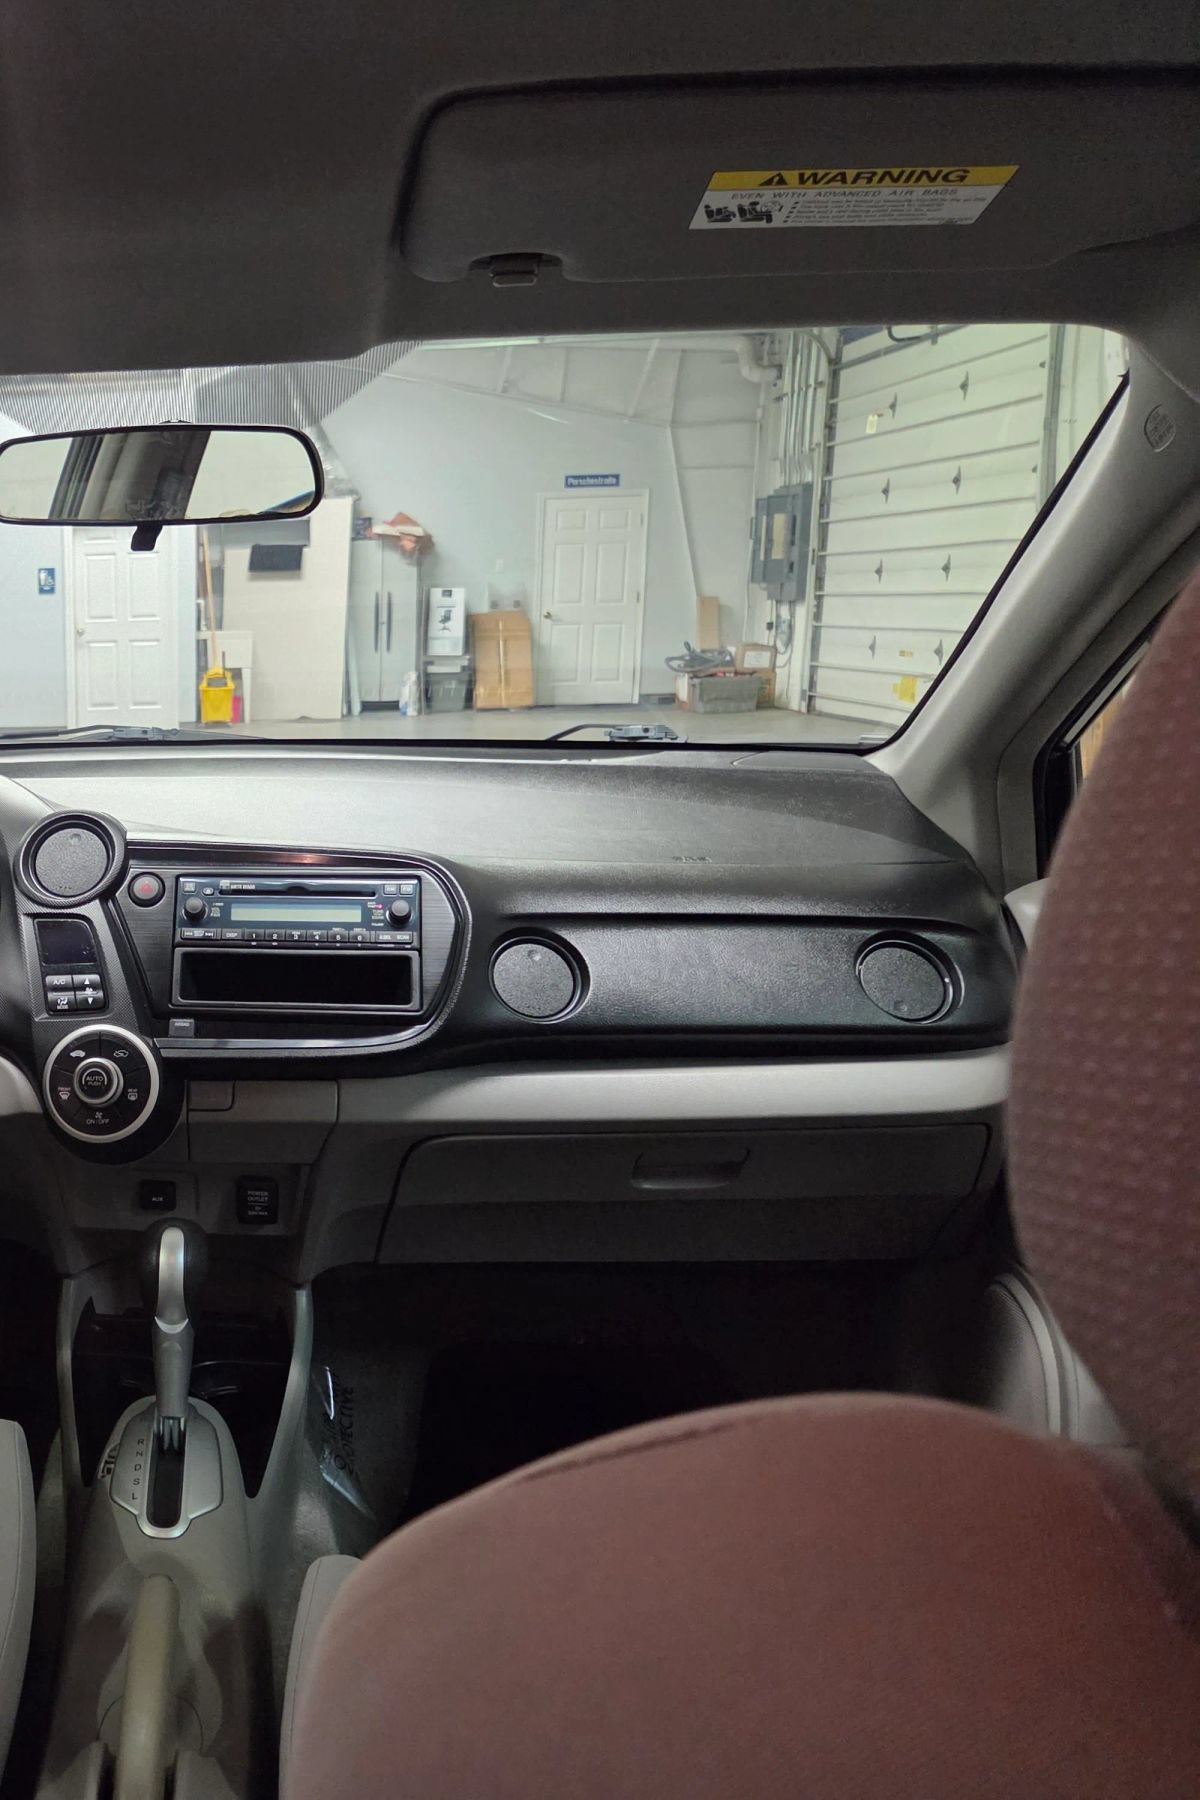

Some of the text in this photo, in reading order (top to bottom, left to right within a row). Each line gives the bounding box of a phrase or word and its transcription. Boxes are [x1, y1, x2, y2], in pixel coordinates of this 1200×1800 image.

[796, 168, 971, 186] WARNING
[773, 191, 807, 199] WITH
[814, 190, 881, 198] ADVANCED
[888, 189, 914, 197] AIR
[137, 1438, 145, 1446] R
[134, 1463, 142, 1472] D
[132, 1478, 141, 1486] S
[131, 1492, 138, 1500] L
